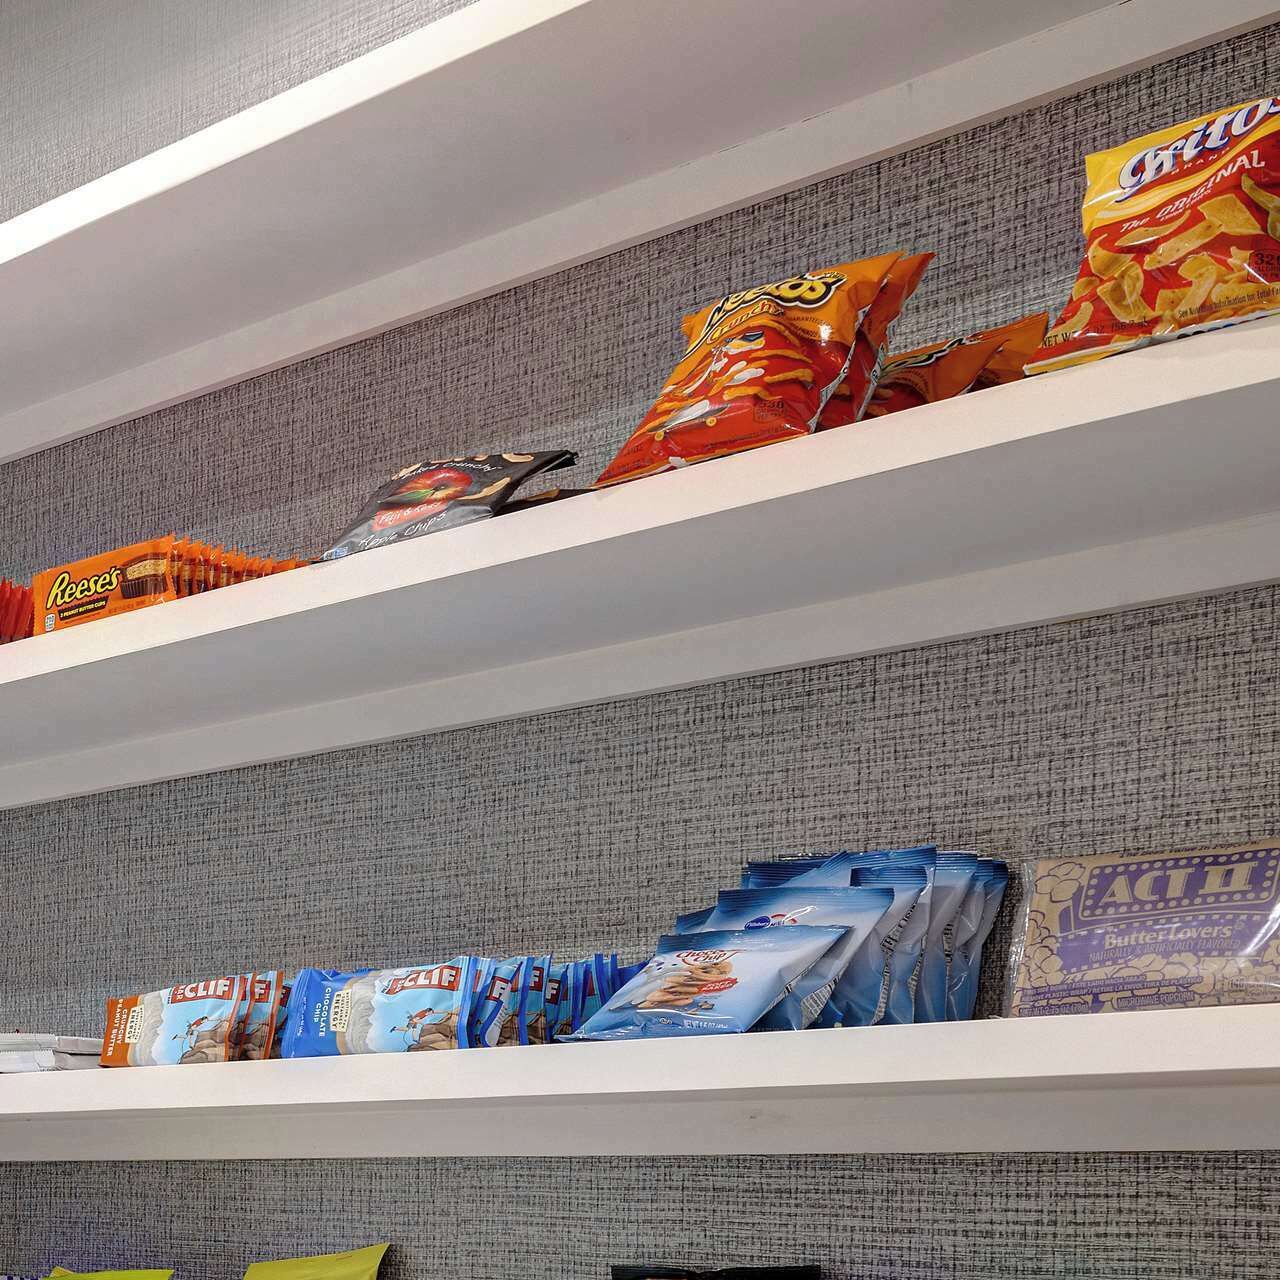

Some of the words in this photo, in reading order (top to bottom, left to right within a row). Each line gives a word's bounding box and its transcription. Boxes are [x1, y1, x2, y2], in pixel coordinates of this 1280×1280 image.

[1157, 151, 1265, 218] ORIGINAL
[405, 512, 447, 536] Chips
[46, 567, 120, 609] Reese's
[1099, 868, 1195, 906] ACT
[1104, 930, 1167, 949] Butter
[1169, 925, 1232, 941] Lovers
[184, 980, 230, 997] CLIF
[404, 968, 457, 987] CLIF
[314, 1003, 322, 1025] CHIP
[319, 987, 332, 1037] CHOCOLATE
